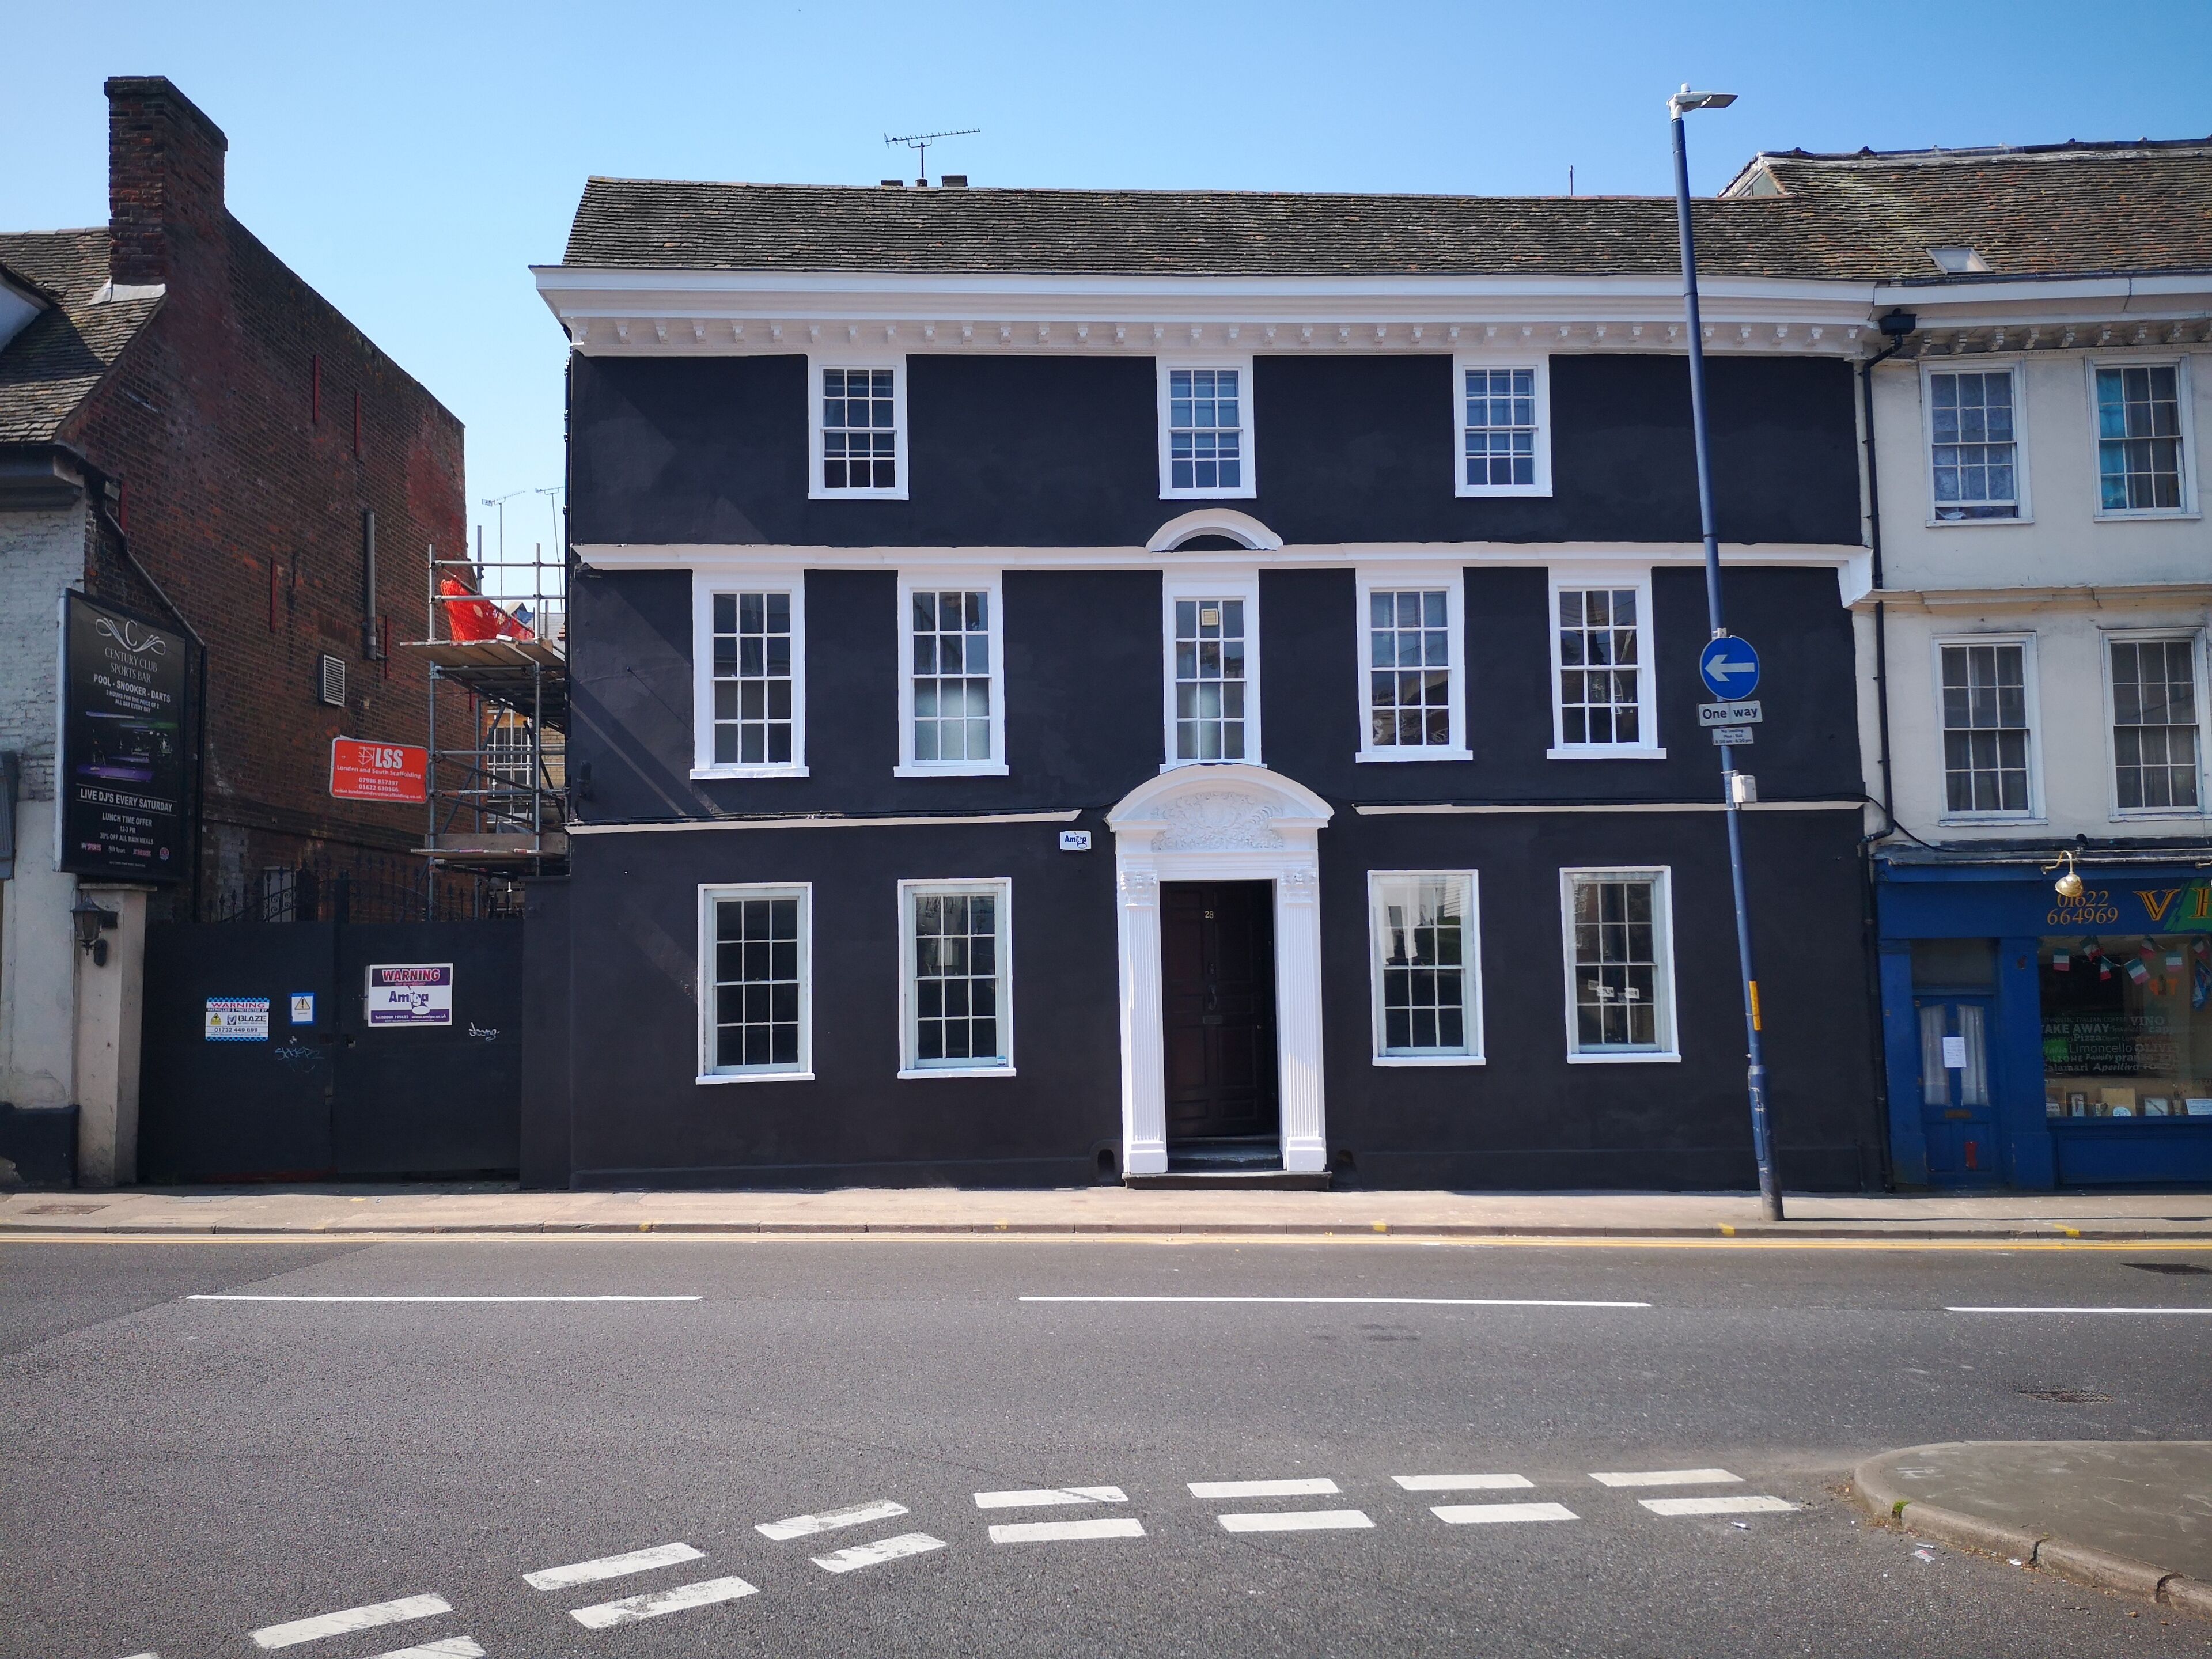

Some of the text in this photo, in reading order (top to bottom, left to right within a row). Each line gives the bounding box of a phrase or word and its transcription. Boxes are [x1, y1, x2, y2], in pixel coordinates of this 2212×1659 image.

[105, 647, 157, 672] CENTURY CLUB
[111, 663, 151, 683] SPORTS BAR
[94, 674, 171, 703] POOL SNOOKER DARTS
[131, 702, 143, 711] EVERY
[140, 698, 150, 707] PRICE
[1703, 708, 1758, 719] One way
[376, 748, 403, 769] LSS
[337, 764, 358, 772] London
[389, 770, 421, 779] Scaffolding
[81, 788, 172, 812] LIVE DJ'S EVERY SATURDAY
[103, 812, 152, 827] LUNCH TIME OFFER
[140, 837, 153, 845] MEALS
[2057, 890, 2109, 908] 01622
[1205, 910, 1214, 919] 28
[2047, 907, 2119, 925] 664969
[382, 969, 441, 982] WARNING
[2131, 1016, 2165, 1026] VINO
[2073, 1024, 2111, 1033] AWAY
[2074, 1033, 2103, 1041] Pizza
[2069, 1042, 2132, 1054] Limoncello
[2085, 1053, 2113, 1062] Family
[2092, 1062, 2139, 1072] Aperitivo
